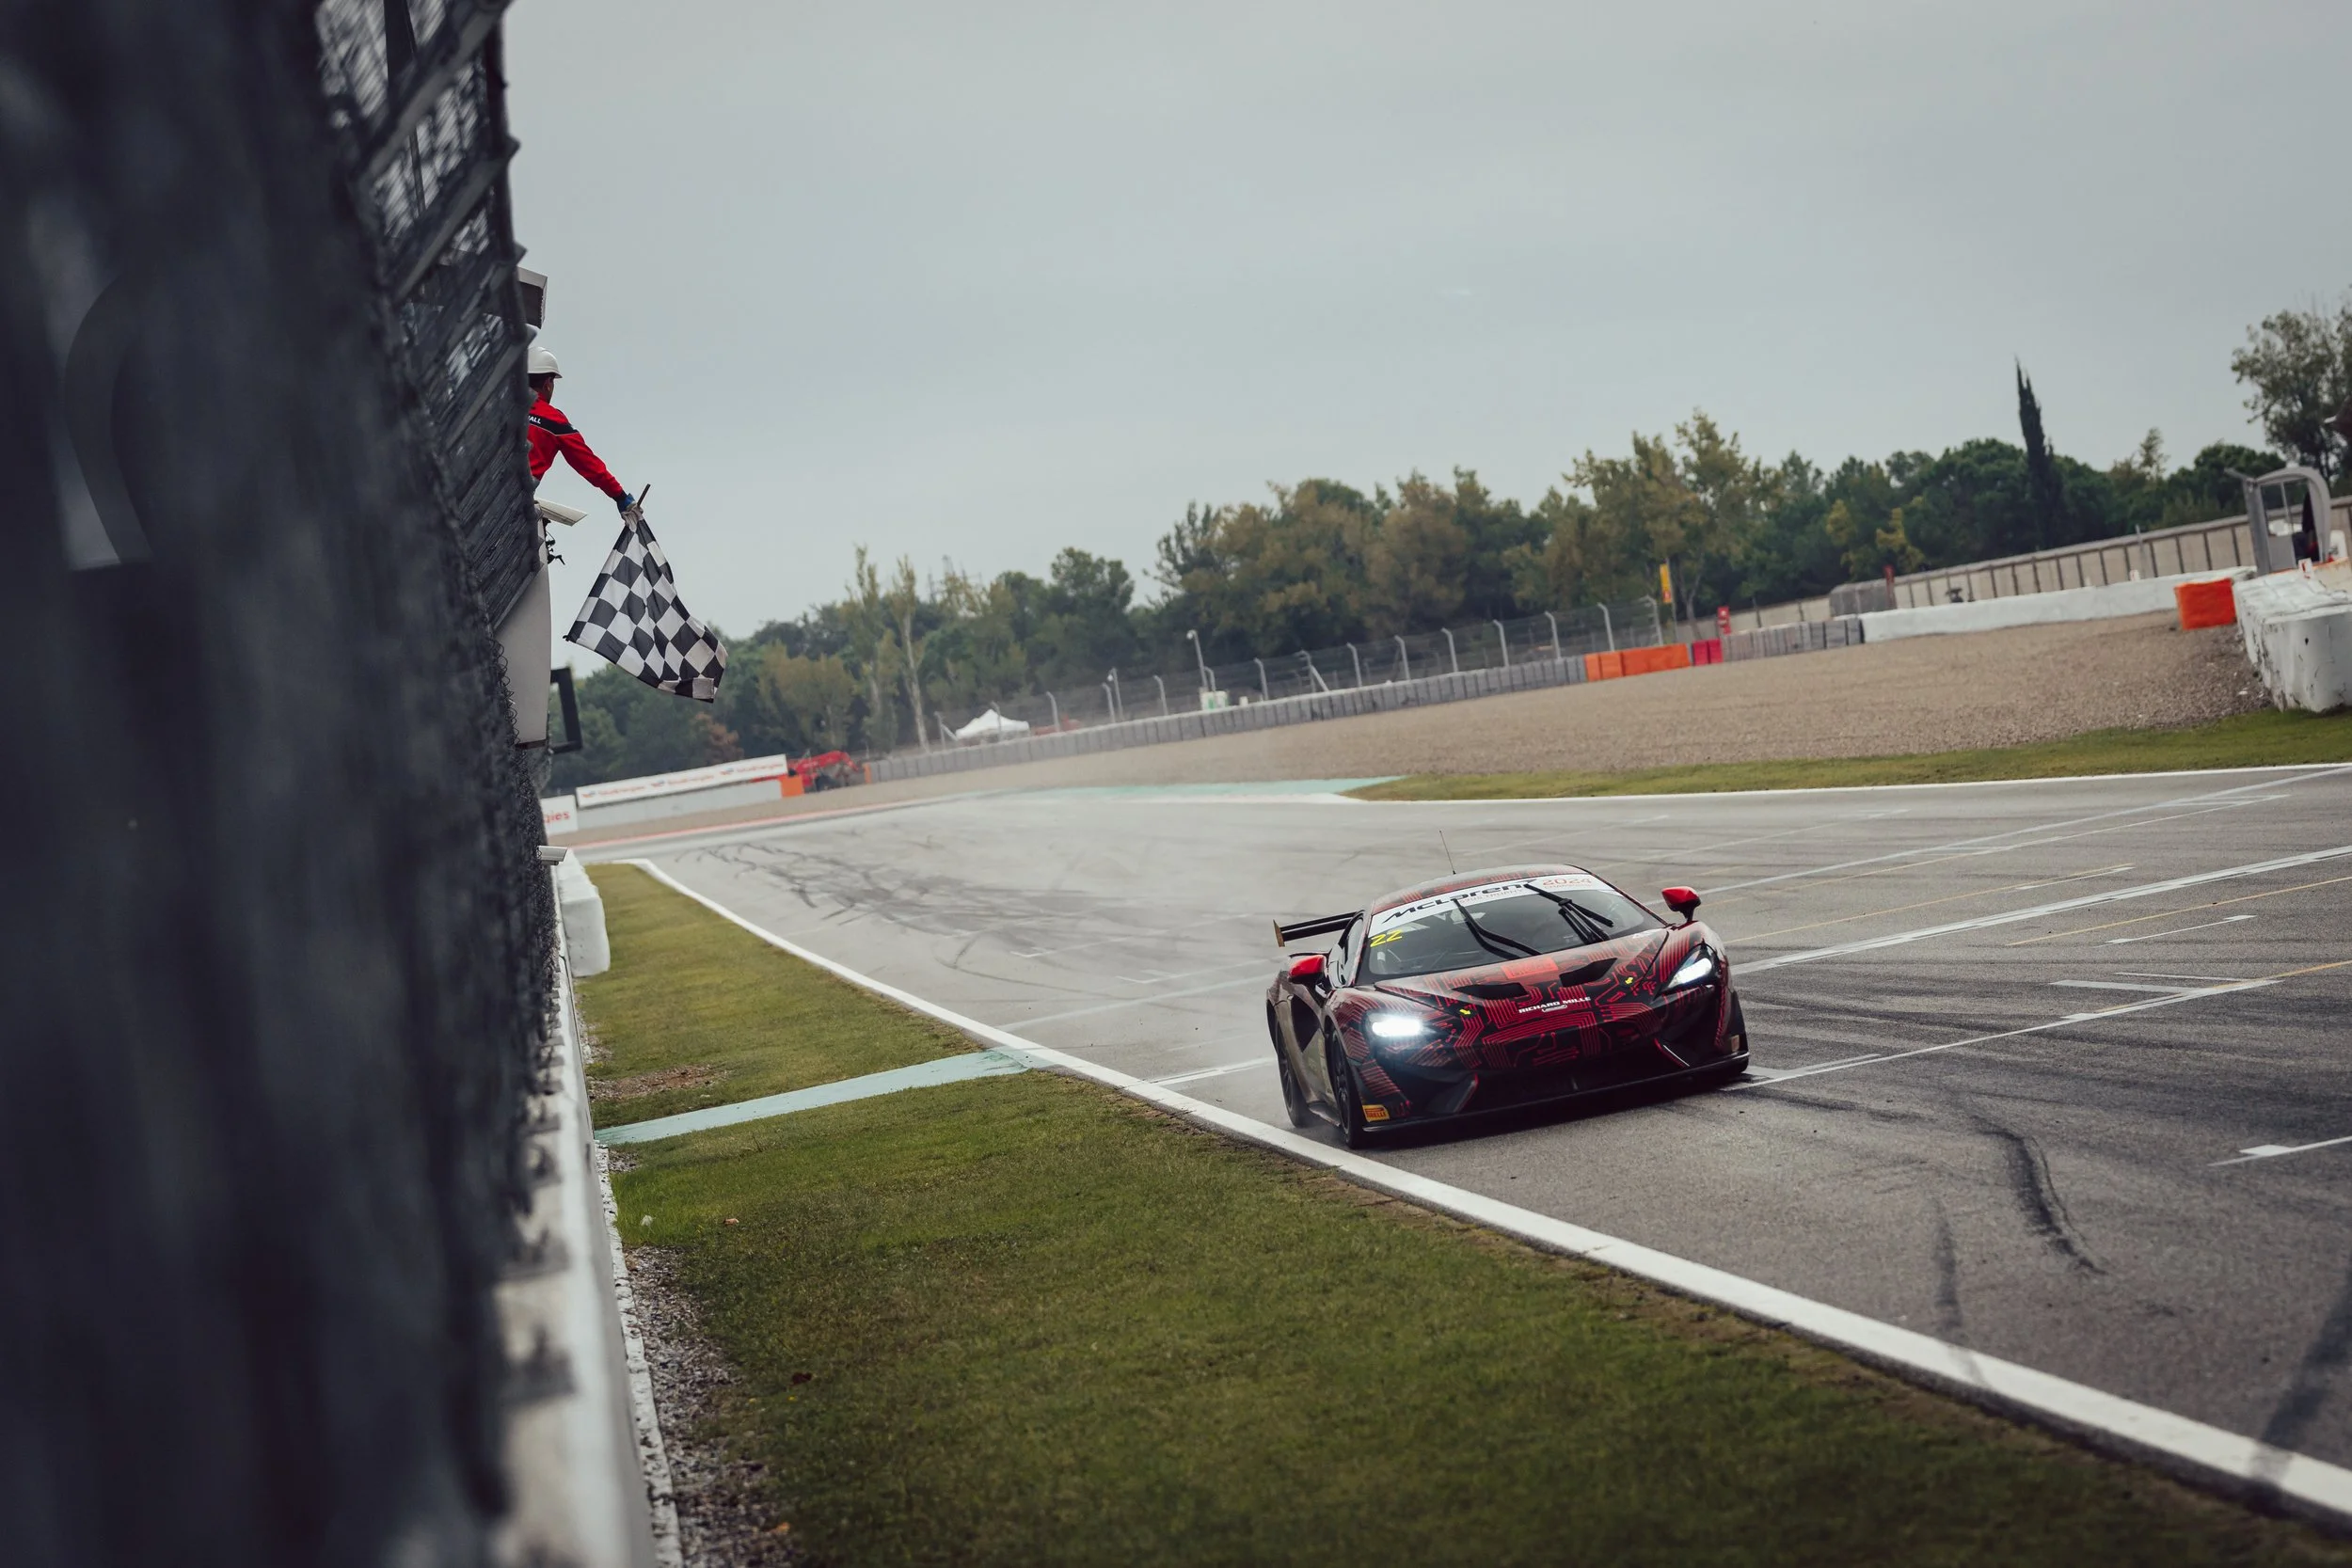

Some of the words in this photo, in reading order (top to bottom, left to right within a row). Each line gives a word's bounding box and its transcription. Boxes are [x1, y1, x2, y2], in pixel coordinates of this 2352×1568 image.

[528, 415, 541, 424] ALL
[1542, 878, 1592, 886] 2024
[1382, 883, 1523, 925] McLaren
[1370, 929, 1403, 947] 22
[1518, 1001, 1561, 1014] RICHARD
[1562, 996, 1592, 1006] MILLE
